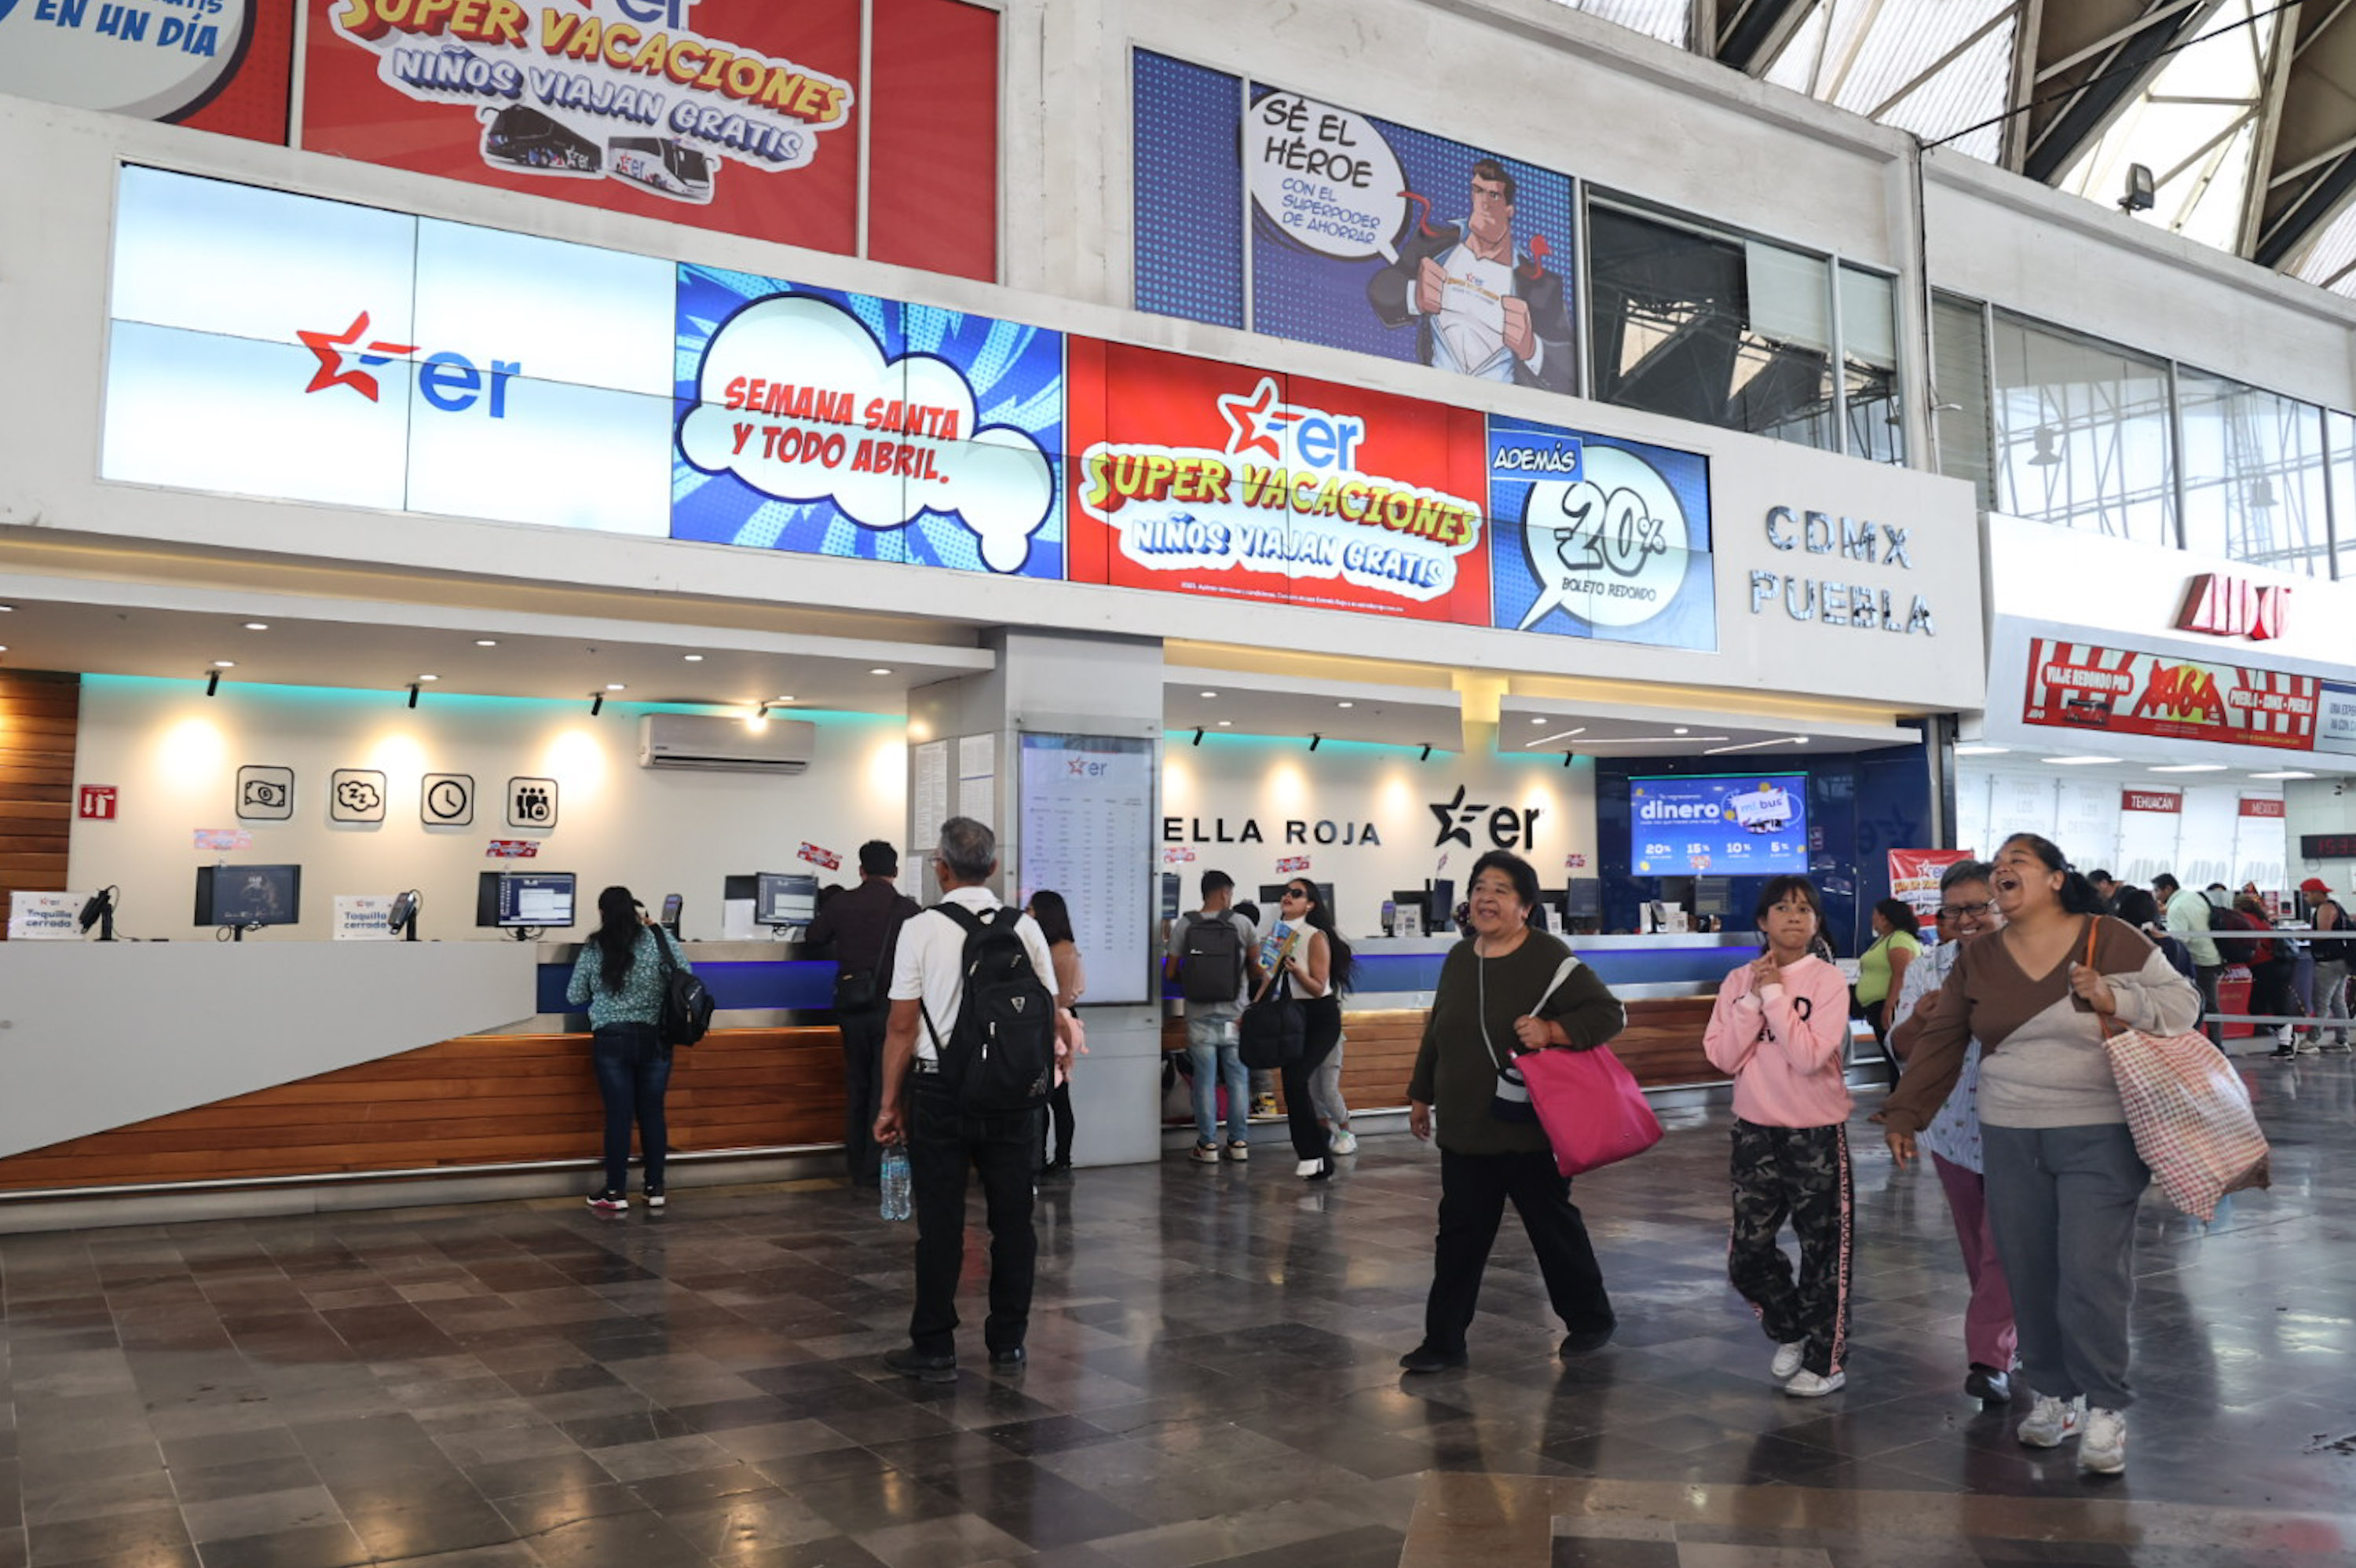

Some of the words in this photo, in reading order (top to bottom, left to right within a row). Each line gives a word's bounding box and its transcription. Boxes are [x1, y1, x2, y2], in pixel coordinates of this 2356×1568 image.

[35, 0, 86, 27] EN
[96, 4, 151, 42] UN
[157, 13, 218, 57] DÍA
[340, 0, 526, 46] SUPER
[542, 8, 847, 122] VACACIONES
[393, 45, 522, 100] NIÑOS
[529, 67, 665, 126] VIAJAN
[671, 100, 803, 162] GRATIS
[1263, 98, 1308, 133] SÉ
[1318, 114, 1357, 147] EL
[1264, 135, 1374, 188] HÉROE
[1282, 177, 1314, 197] CON
[1318, 187, 1337, 203] EL
[1282, 194, 1381, 229] SUPERPODER
[1282, 210, 1302, 228] DE
[1308, 218, 1375, 244] AHORRAR
[419, 351, 521, 418] er
[724, 376, 854, 425] SEMANA
[864, 398, 959, 440] SANTA
[732, 422, 754, 455] Y
[762, 426, 846, 469] TODO
[851, 438, 949, 484] ABRIL.
[1297, 416, 1358, 471] er
[1494, 443, 1576, 473] ADEMÁS
[1087, 451, 1231, 511] SUPER
[1242, 463, 1478, 546] VACACIONES
[1132, 512, 1231, 555] NIÑOS
[1234, 524, 1337, 565] VIAJAN
[1344, 539, 1447, 588] GRATIS
[1765, 505, 1913, 569] CDMX
[1562, 577, 1604, 596] BOLETO
[1608, 583, 1656, 602] REDONDO
[1749, 568, 1937, 637] PUEBLA
[1088, 762, 1107, 776] er
[1489, 803, 1539, 850] er
[1640, 799, 1720, 820] dinero
[1759, 799, 1783, 810] bus
[1286, 819, 1381, 846] ROJA
[1645, 843, 1671, 855] 20%
[26, 908, 71, 919] Taquilla
[344, 911, 386, 921] Taquilla
